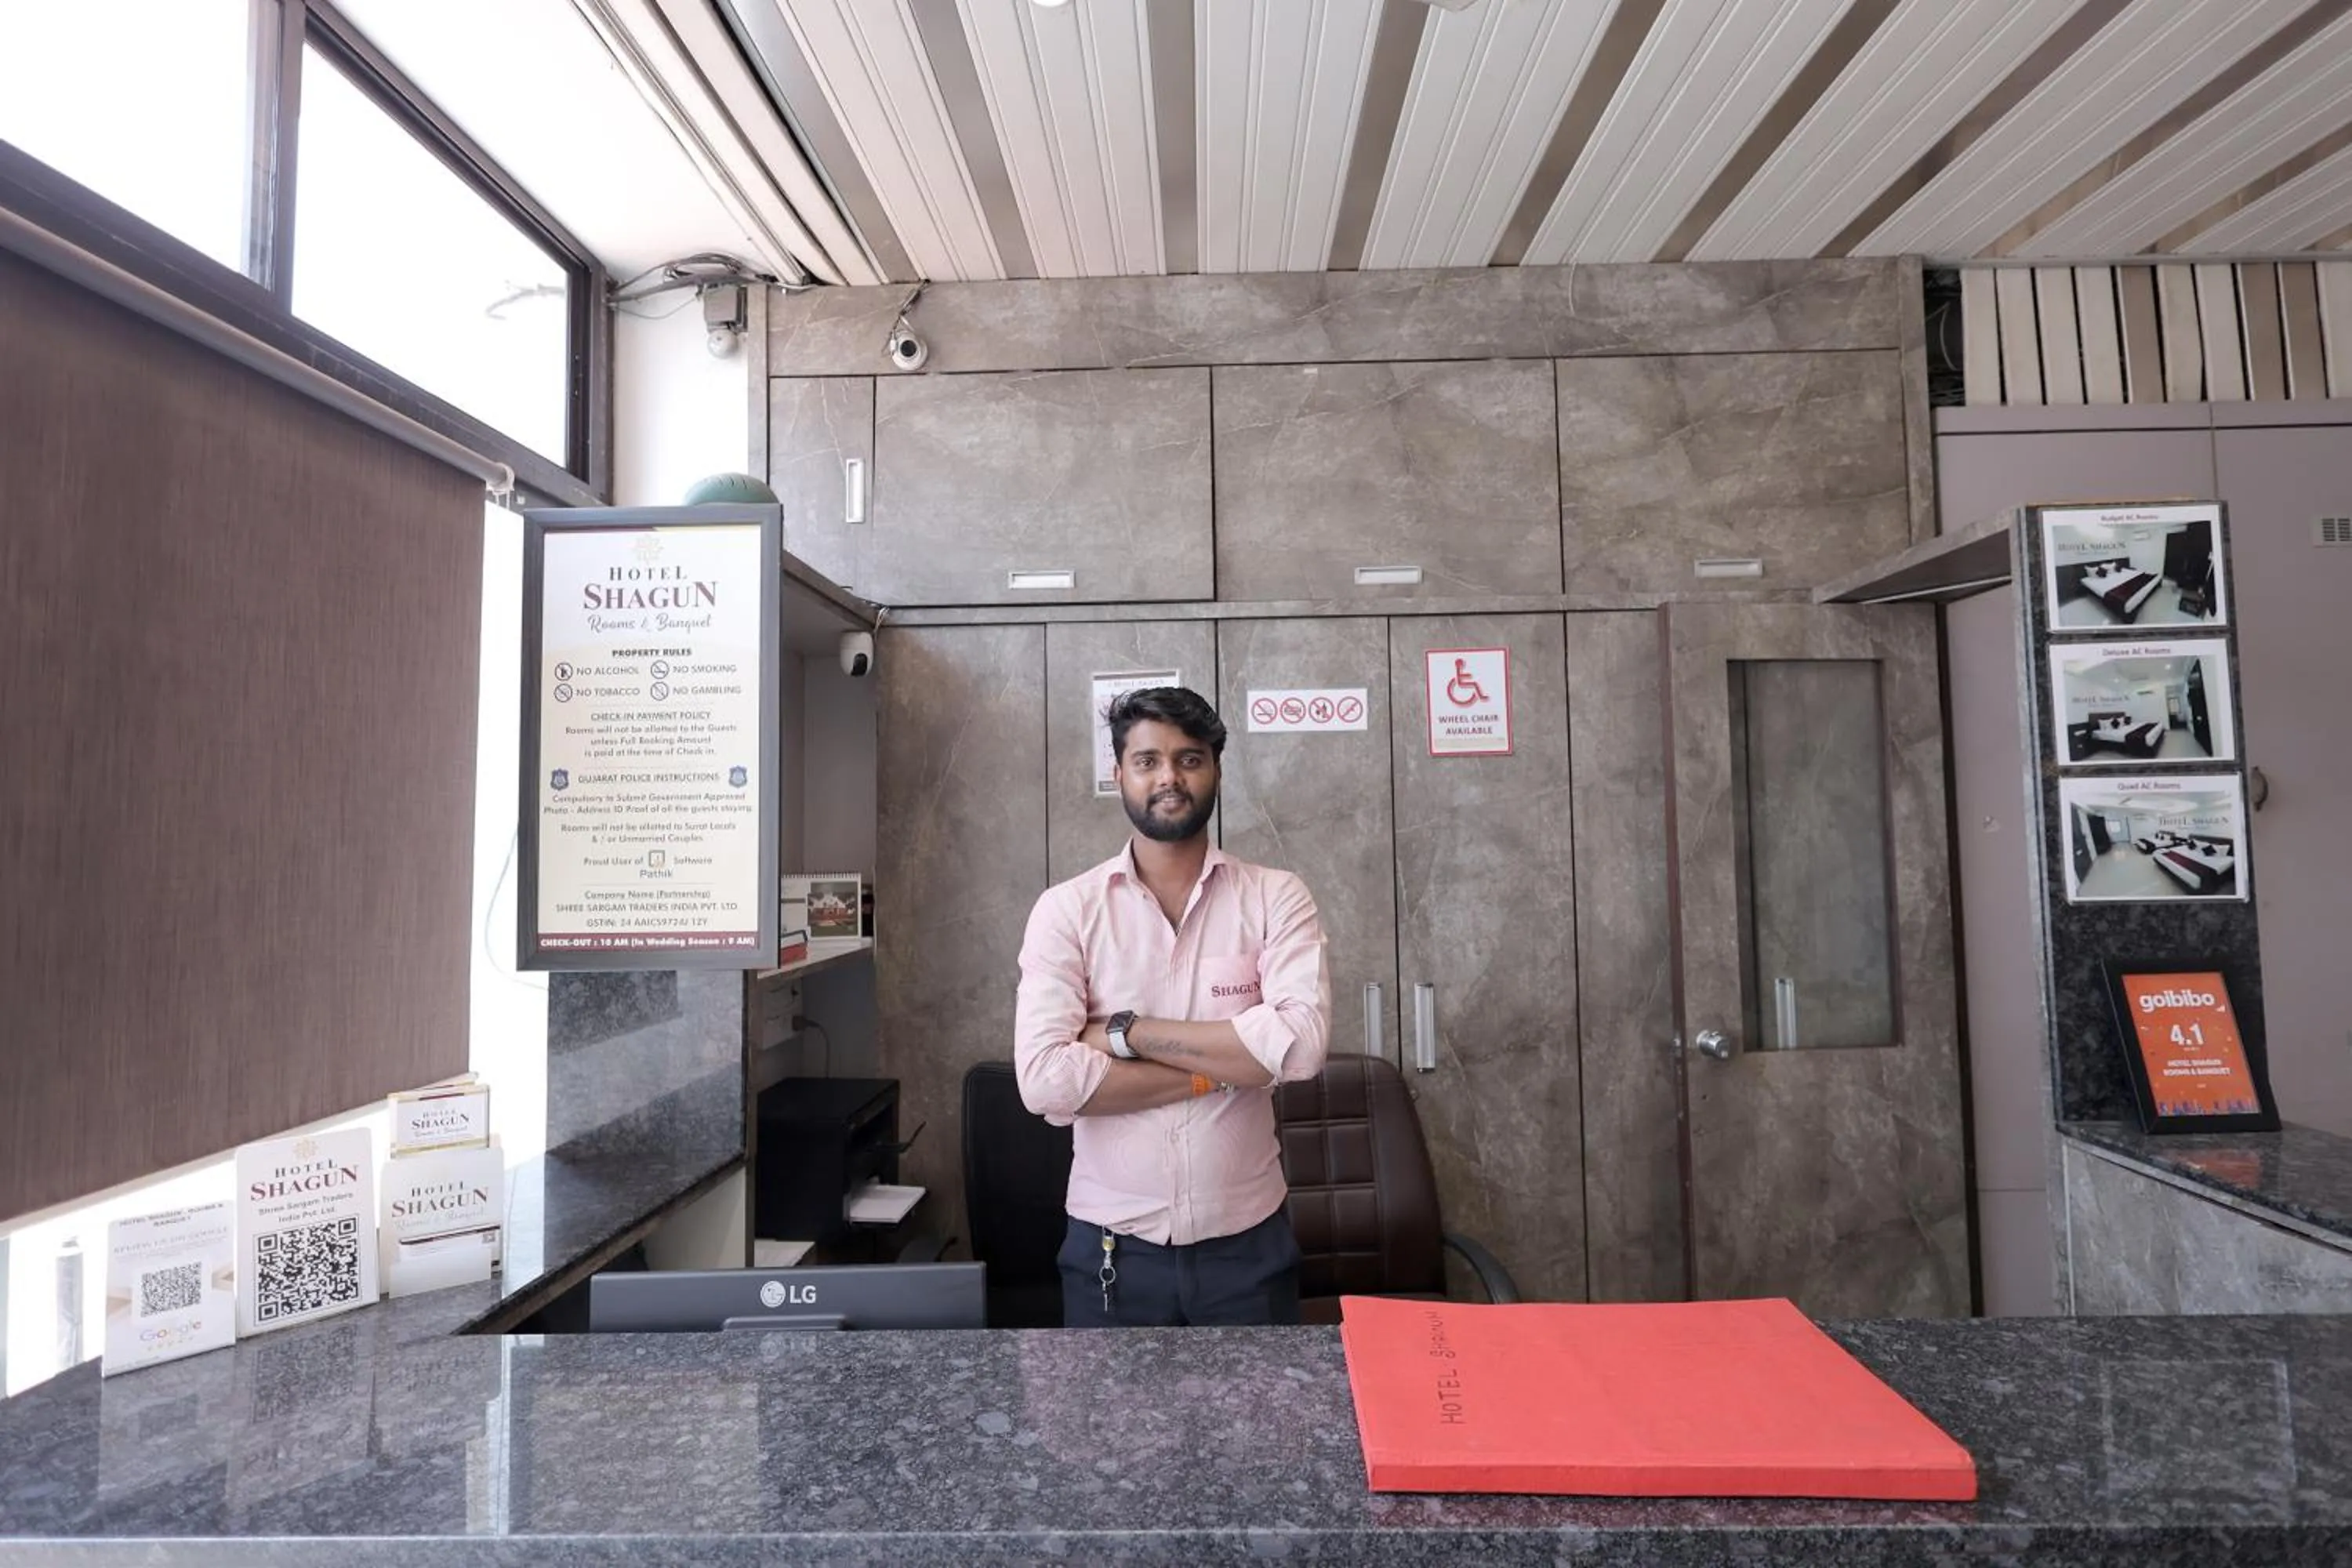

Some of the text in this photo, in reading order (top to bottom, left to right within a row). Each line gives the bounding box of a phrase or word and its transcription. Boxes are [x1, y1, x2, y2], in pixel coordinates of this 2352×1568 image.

[609, 565, 688, 581] HOTEL
[583, 581, 718, 611] SHAGUN
[588, 614, 636, 633] Rooms
[655, 612, 712, 634] Banquet
[612, 648, 692, 657] PROPERTY RULES
[2102, 648, 2130, 657] Deluxe
[576, 666, 639, 676] NO ALCOHOL
[673, 664, 738, 673] NO SMOKING
[576, 688, 641, 697] NO TOBACCO
[691, 685, 742, 695] GAMBLING
[637, 711, 677, 720] PAYMENT
[680, 710, 711, 720] POLICY
[1438, 715, 1468, 724] WHEEL
[565, 726, 593, 735] Rooms
[597, 724, 612, 734] will
[631, 725, 642, 734] be
[691, 724, 705, 732] the
[707, 723, 737, 732] Guests
[1445, 726, 1493, 735] AVAILABLE
[578, 772, 720, 783] GUJARAT POLICE INSTRUCTIONS
[2118, 782, 2139, 791] Quad
[2154, 782, 2181, 790] Rooms
[640, 869, 673, 879] Pathik
[587, 902, 626, 913] SARGAM
[629, 902, 669, 912] TRADERS
[670, 902, 699, 911] INDIA
[2140, 989, 2215, 1012] goibibo
[2170, 1023, 2204, 1045] 4.1
[412, 1112, 470, 1130] SHAGUN
[274, 1158, 338, 1178] HOTEL
[250, 1164, 359, 1201] SHAGUN
[411, 1180, 468, 1198] HOTEL
[259, 1192, 354, 1215] Shree Sargam Traders
[391, 1186, 488, 1218] SHAGUN
[278, 1214, 300, 1222] India
[789, 1285, 817, 1304] LG
[140, 1319, 201, 1341] Google
[1438, 1369, 1466, 1425] HOTEL
